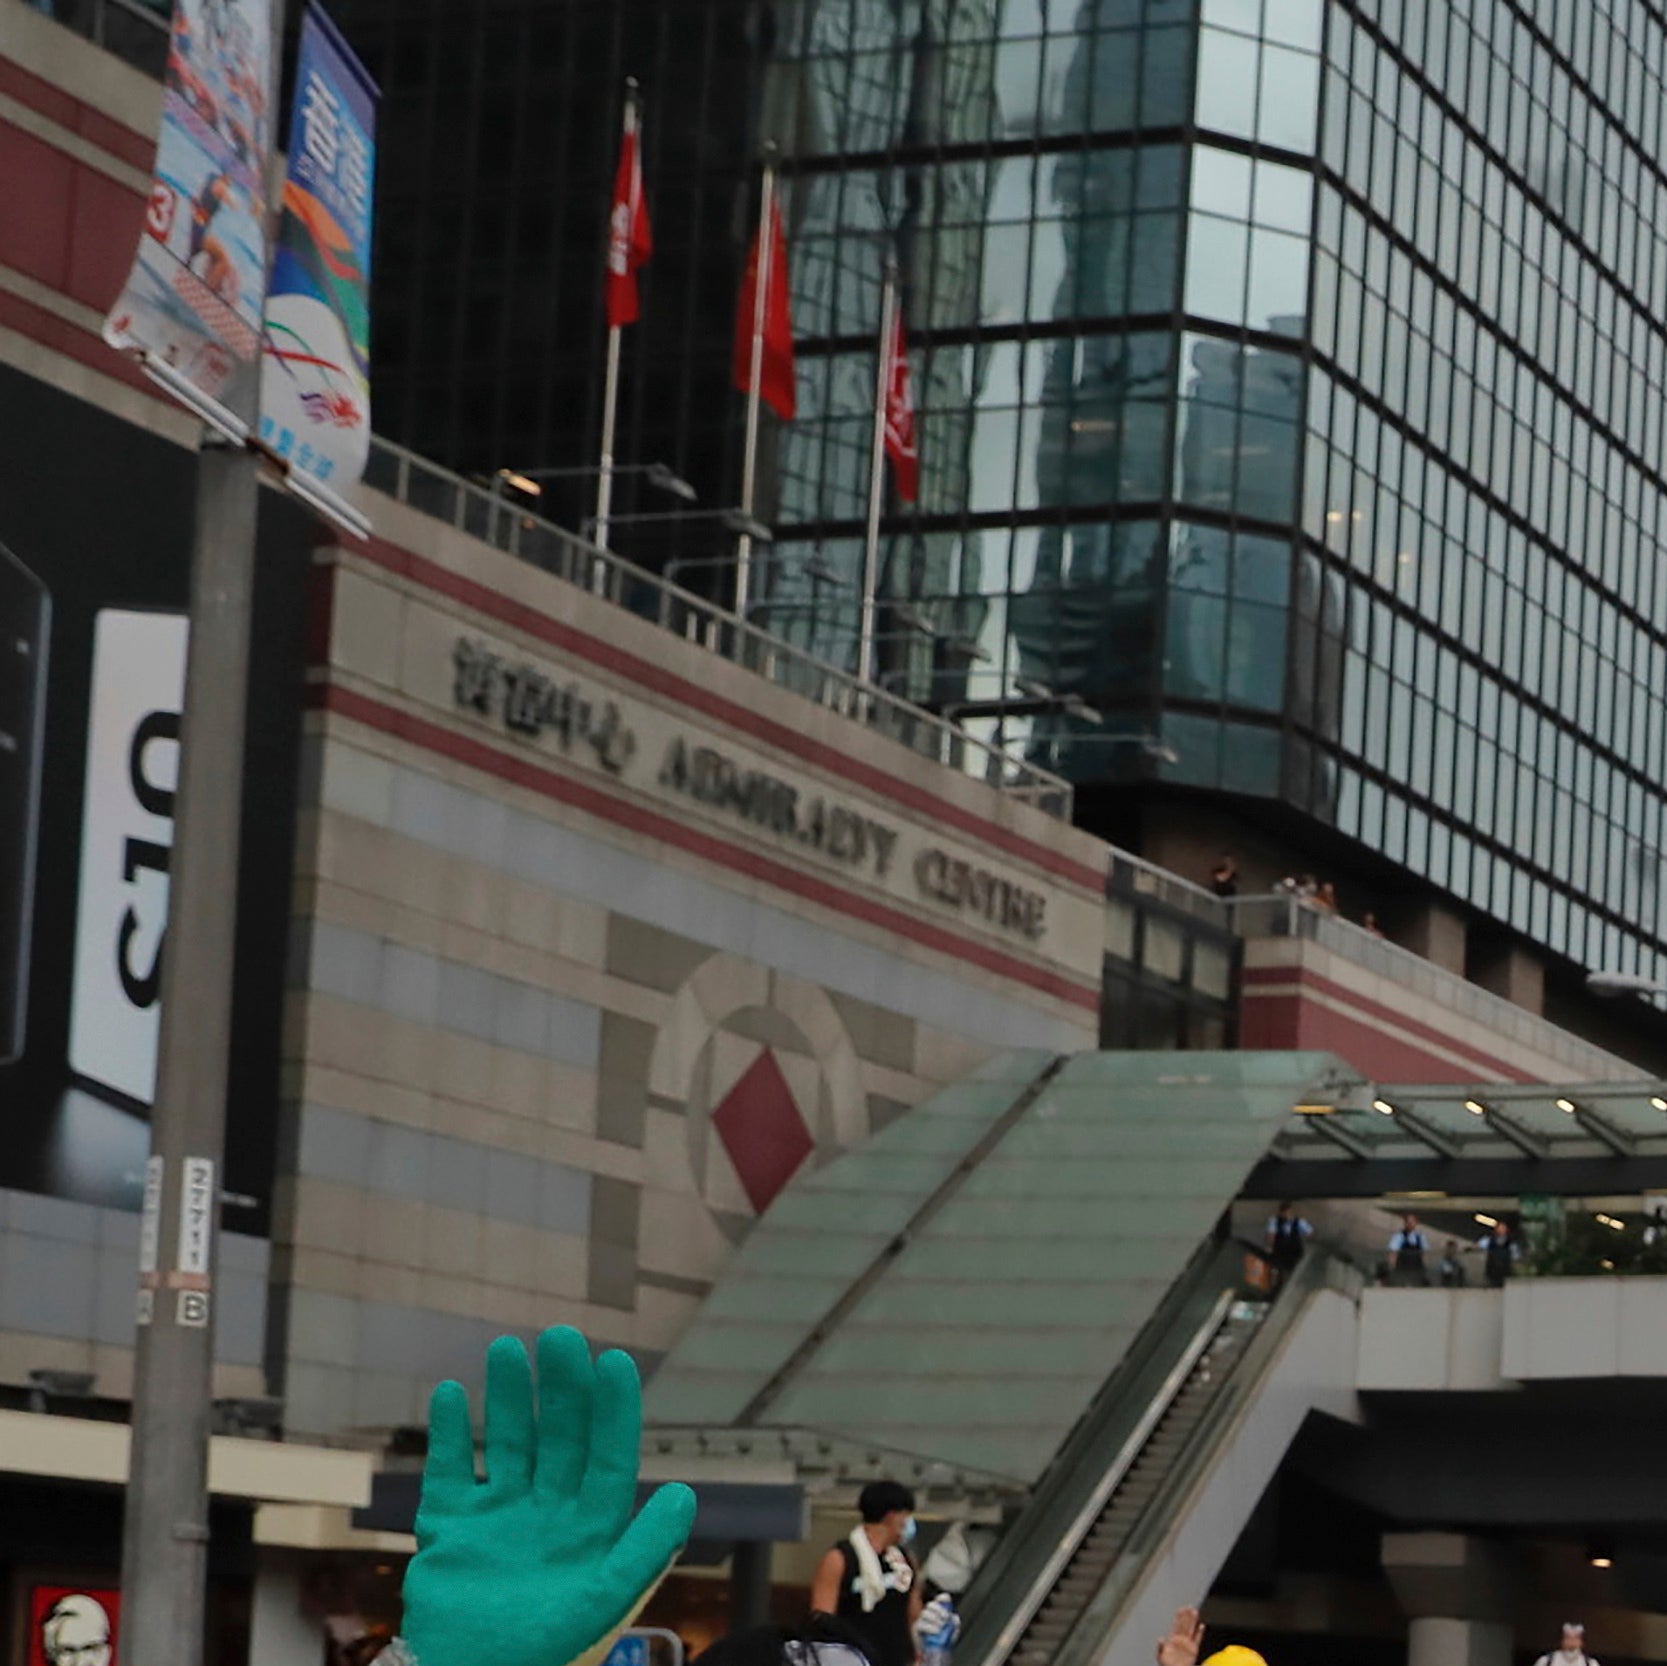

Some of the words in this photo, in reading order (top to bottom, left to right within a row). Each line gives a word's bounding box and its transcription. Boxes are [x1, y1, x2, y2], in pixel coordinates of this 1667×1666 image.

[658, 735, 898, 878] ADMIRALTY
[914, 848, 1048, 942] CENTRE
[185, 1294, 206, 1321] B
